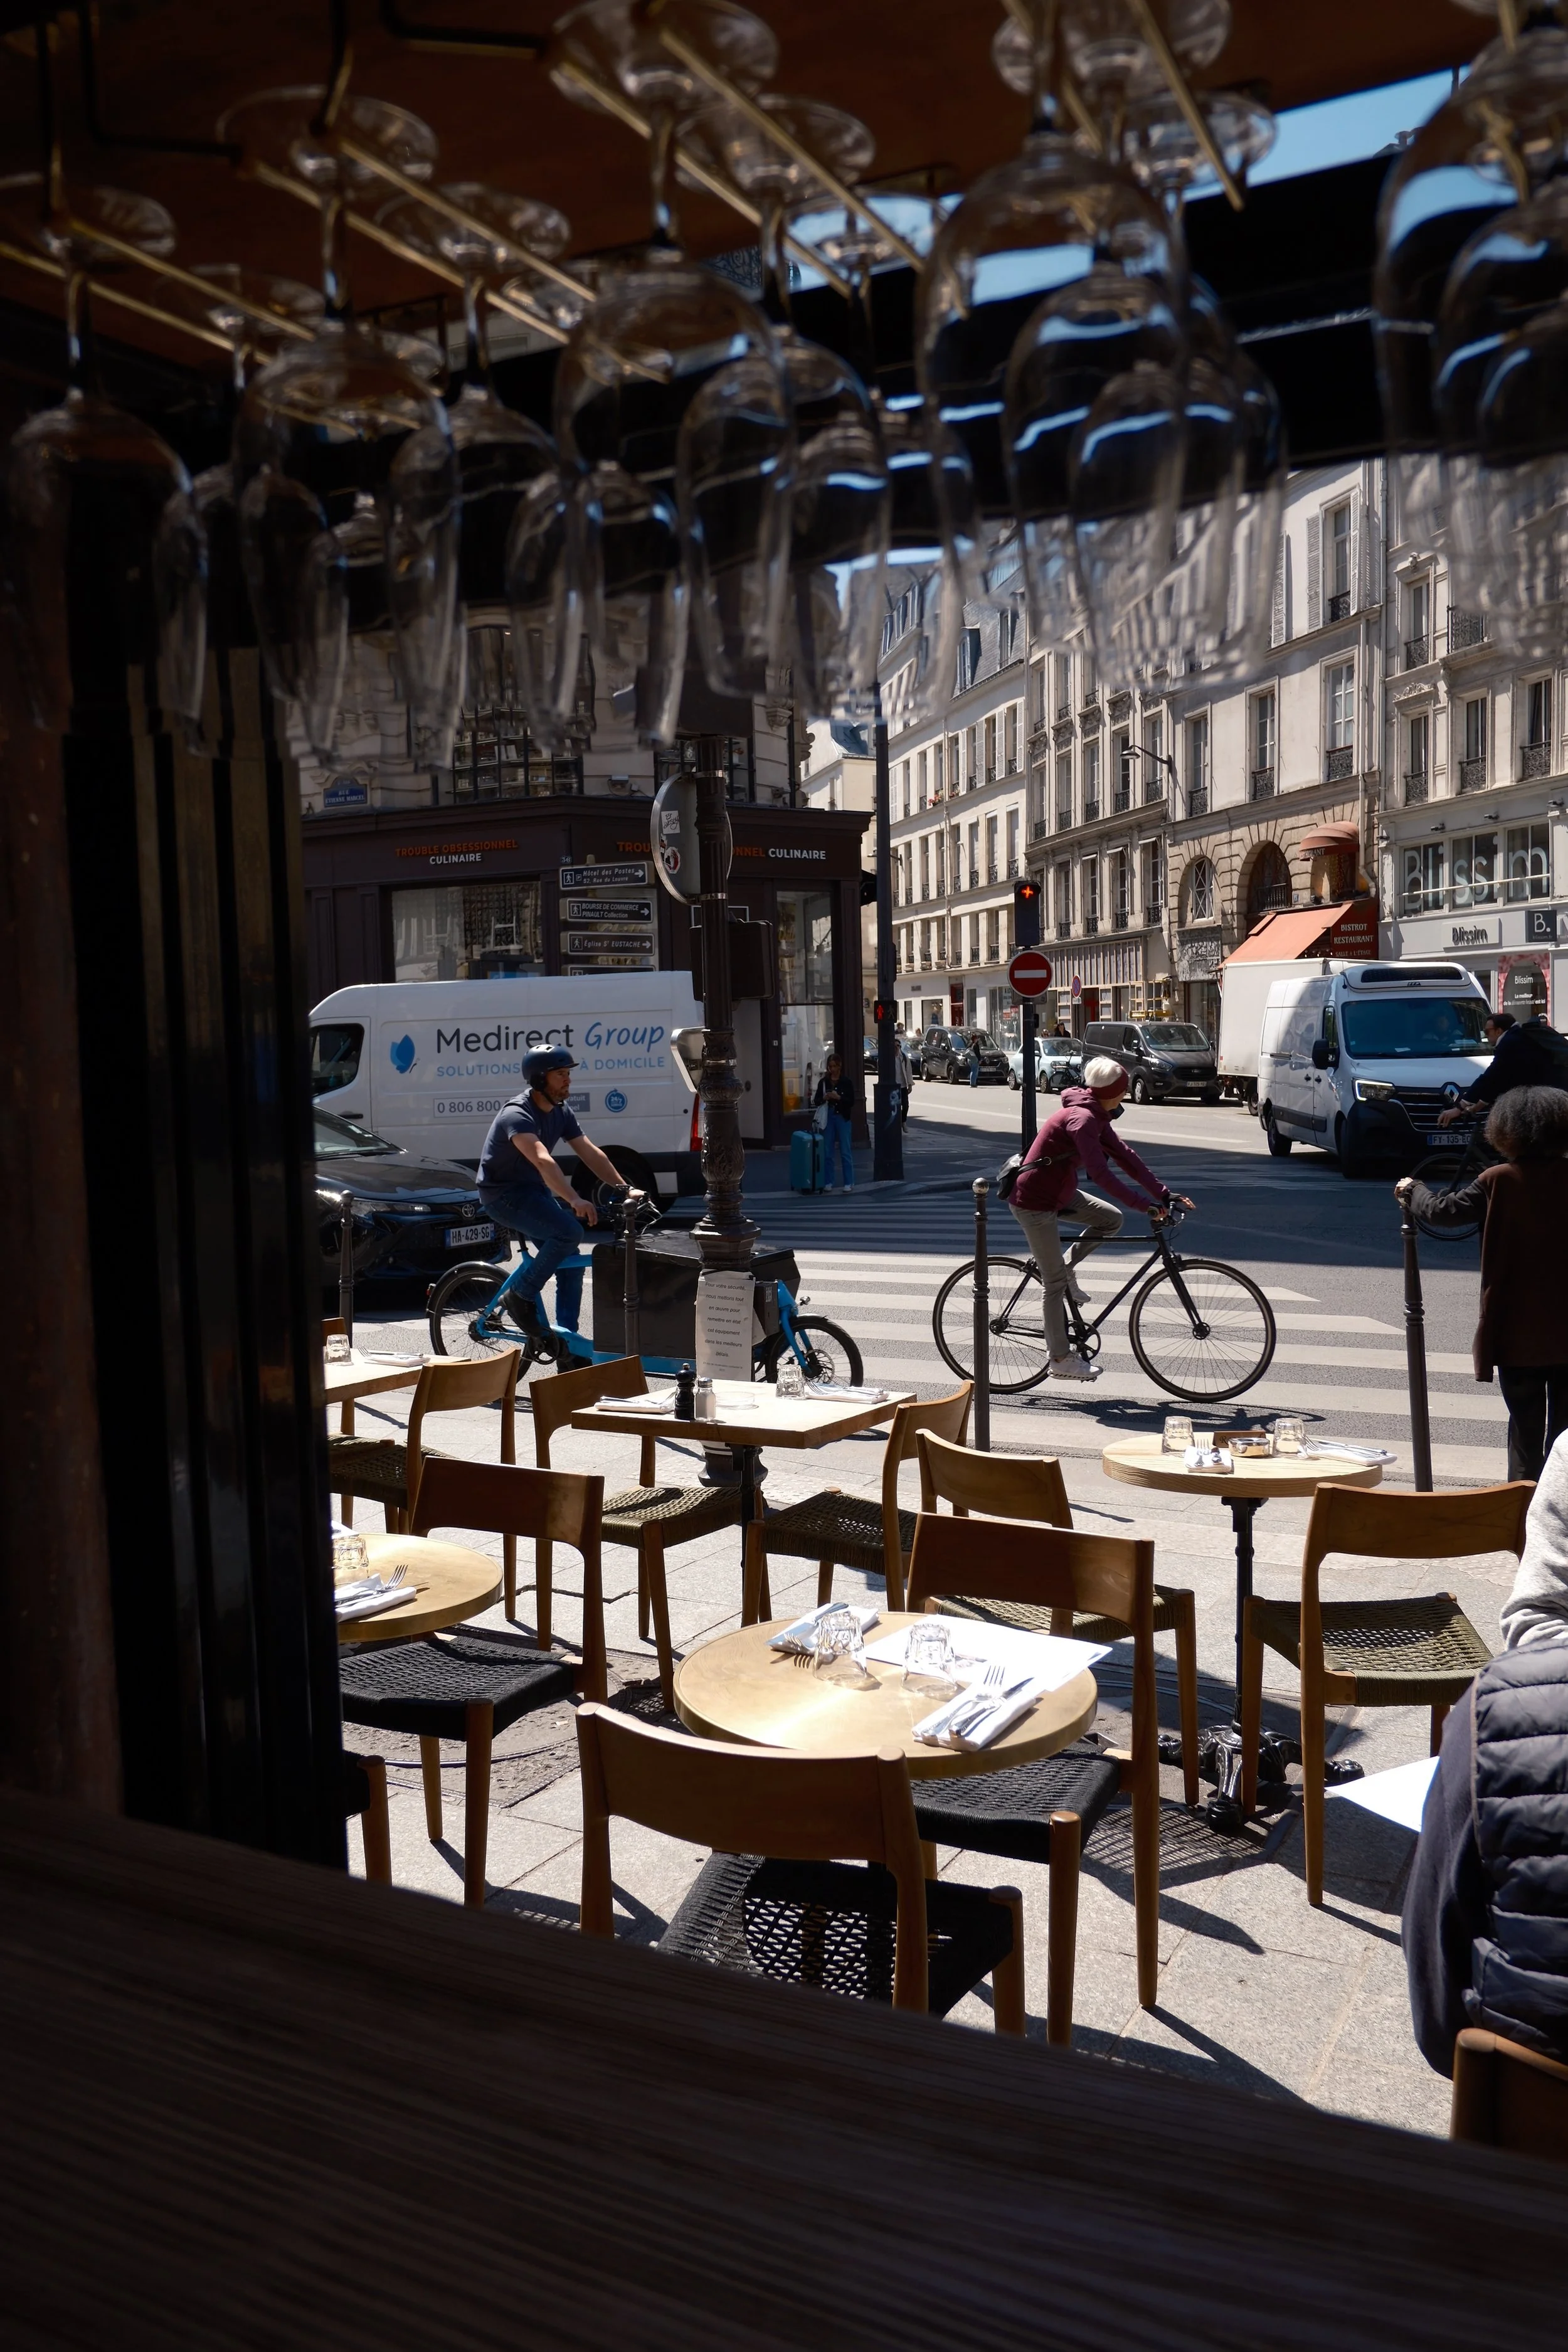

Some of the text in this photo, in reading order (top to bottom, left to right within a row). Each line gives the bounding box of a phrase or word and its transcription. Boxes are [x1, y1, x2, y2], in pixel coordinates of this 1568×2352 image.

[395, 839, 518, 857] TROUBLE OBSESSIONNEL
[617, 842, 650, 852] TROU
[430, 853, 482, 864] CULINAIRE
[768, 848, 826, 860] CULINAIRE
[1404, 835, 1547, 909] Blissim
[1341, 923, 1367, 931] BISTROT
[1534, 913, 1551, 933] B.
[1334, 935, 1374, 944] RESTAURANT
[1452, 926, 1488, 945] Blissim
[584, 938, 601, 948] Église
[612, 940, 641, 949] EUSTACHE
[1515, 975, 1534, 984] Blissim
[436, 1022, 665, 1054] Medirect Group
[437, 1057, 665, 1077] SOLUTIONS À DOMICILE
[437, 1100, 501, 1113] 0 806 800
[452, 1226, 489, 1243] HA-429-SG
